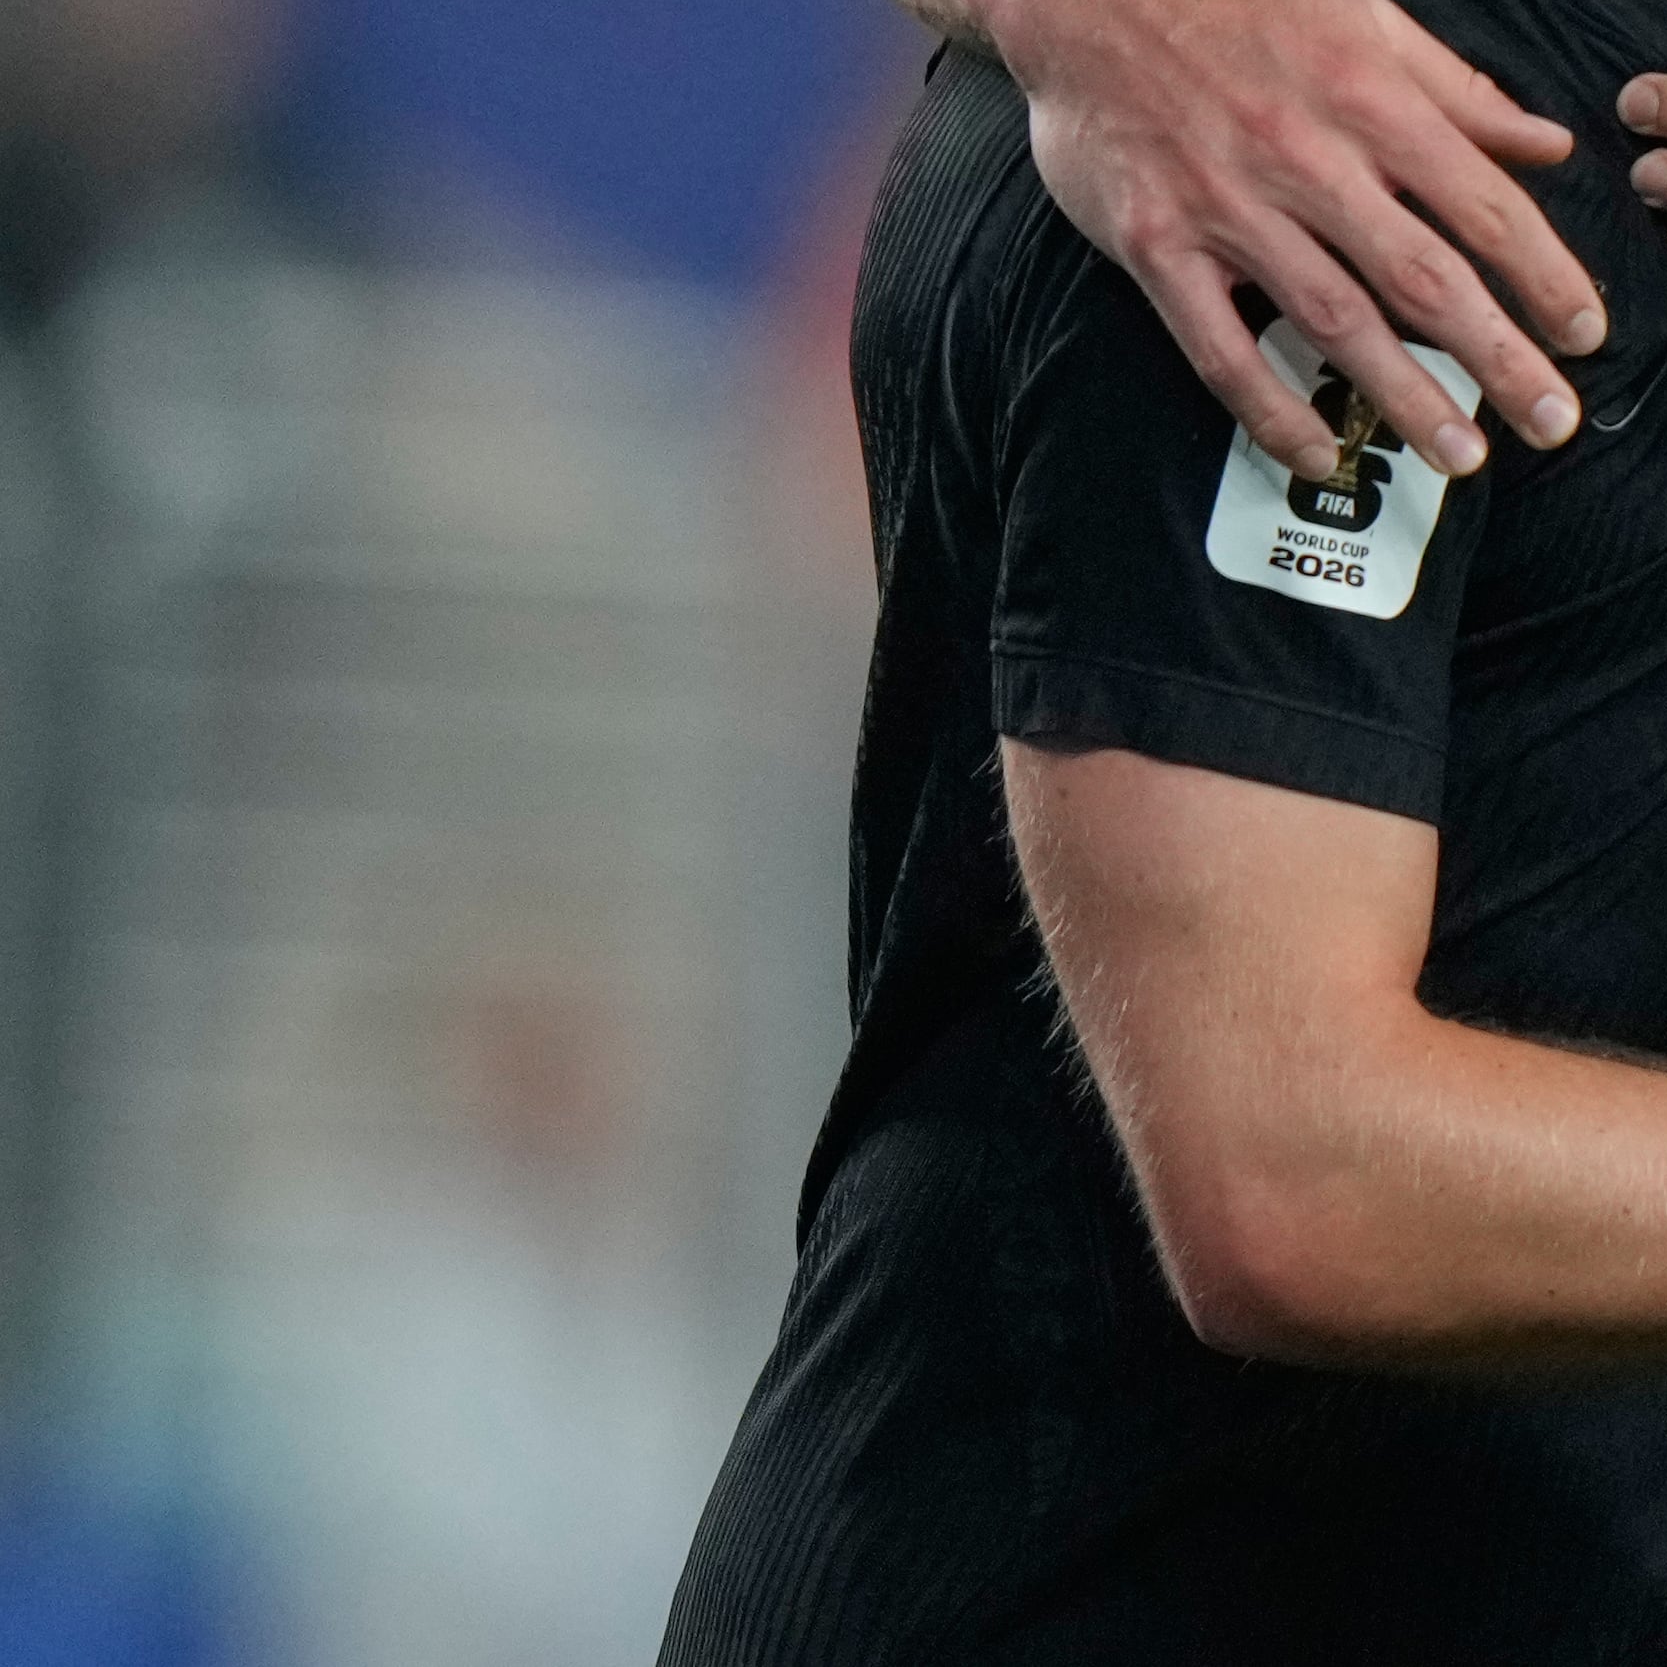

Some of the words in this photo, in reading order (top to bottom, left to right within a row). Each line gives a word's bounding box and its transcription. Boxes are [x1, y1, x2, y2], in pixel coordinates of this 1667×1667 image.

[1316, 490, 1356, 519] FIFA
[1278, 525, 1338, 553] WORLD
[1341, 541, 1370, 560] CUP
[1269, 546, 1366, 588] 2026
